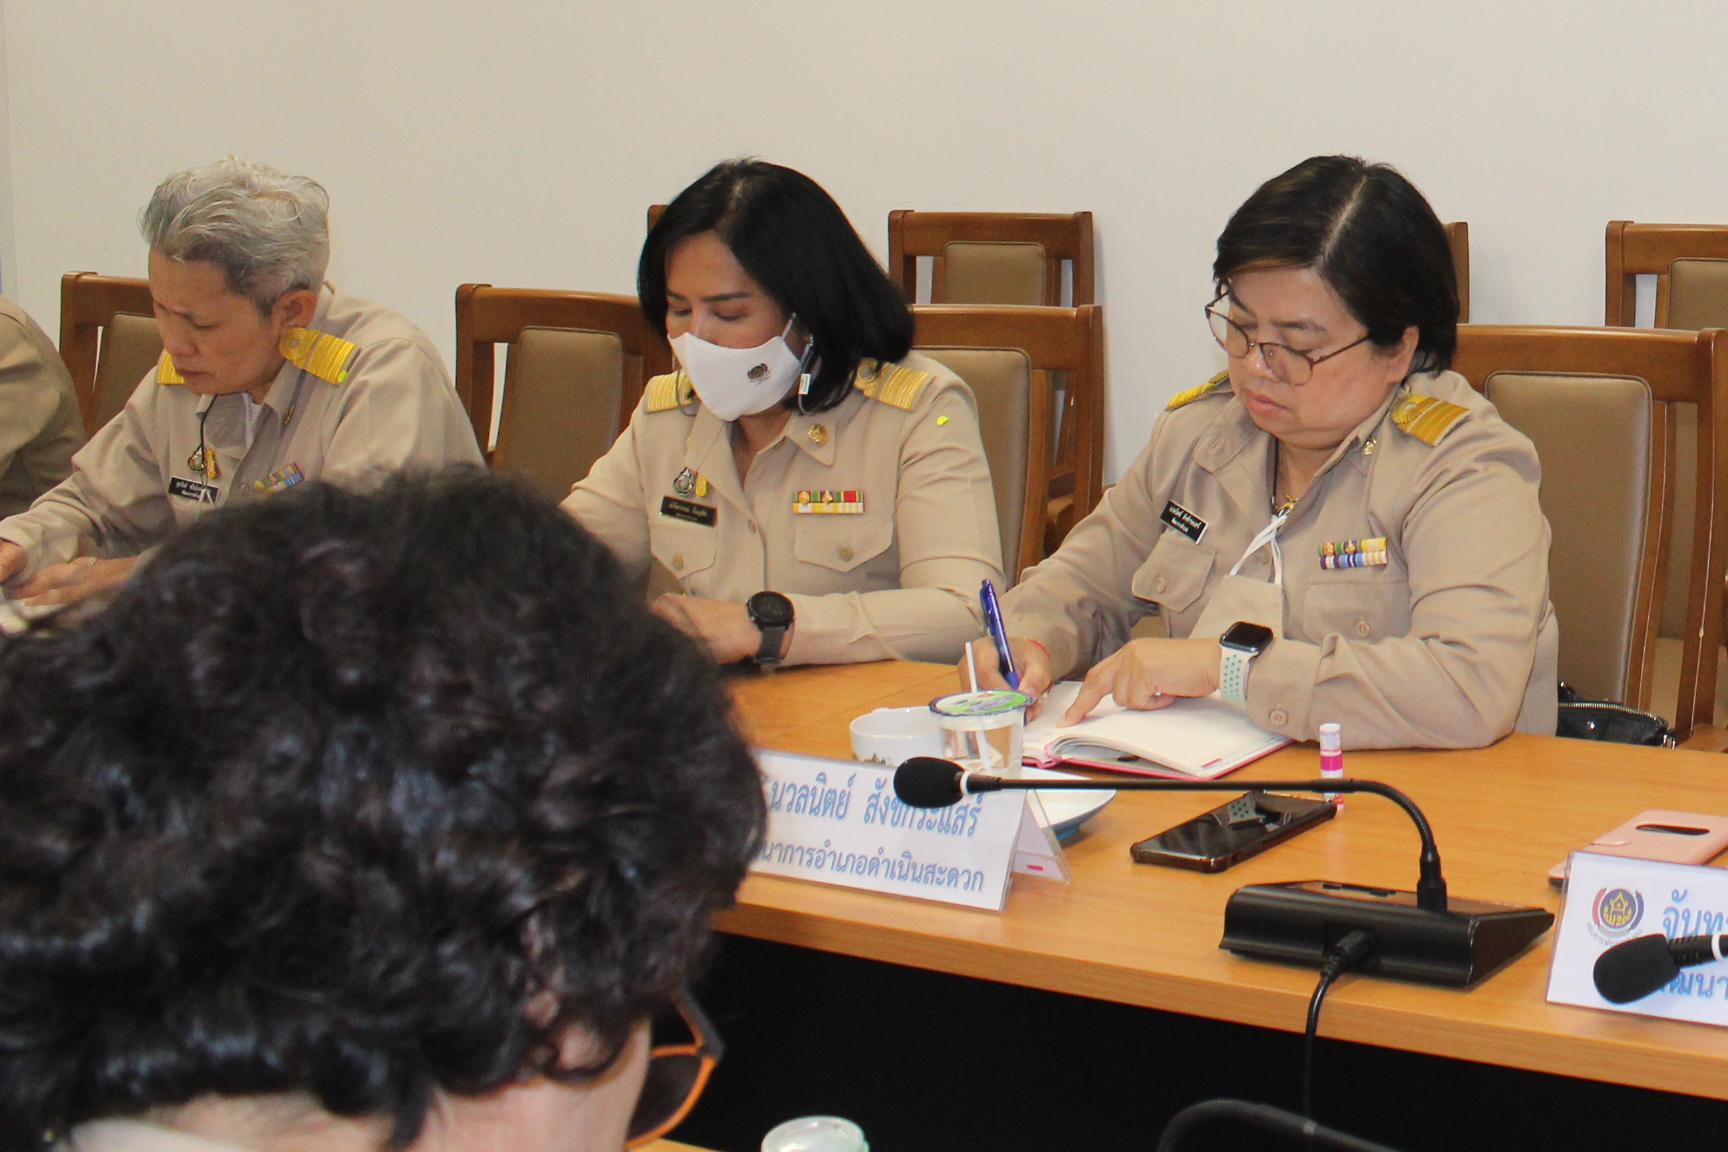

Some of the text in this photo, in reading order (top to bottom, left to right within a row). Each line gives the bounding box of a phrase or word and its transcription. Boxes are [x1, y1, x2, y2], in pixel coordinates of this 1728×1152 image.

[770, 771, 857, 820] นวลนิตย์
[759, 839, 984, 892] นาการอำเภอดำเนินสะดวก
